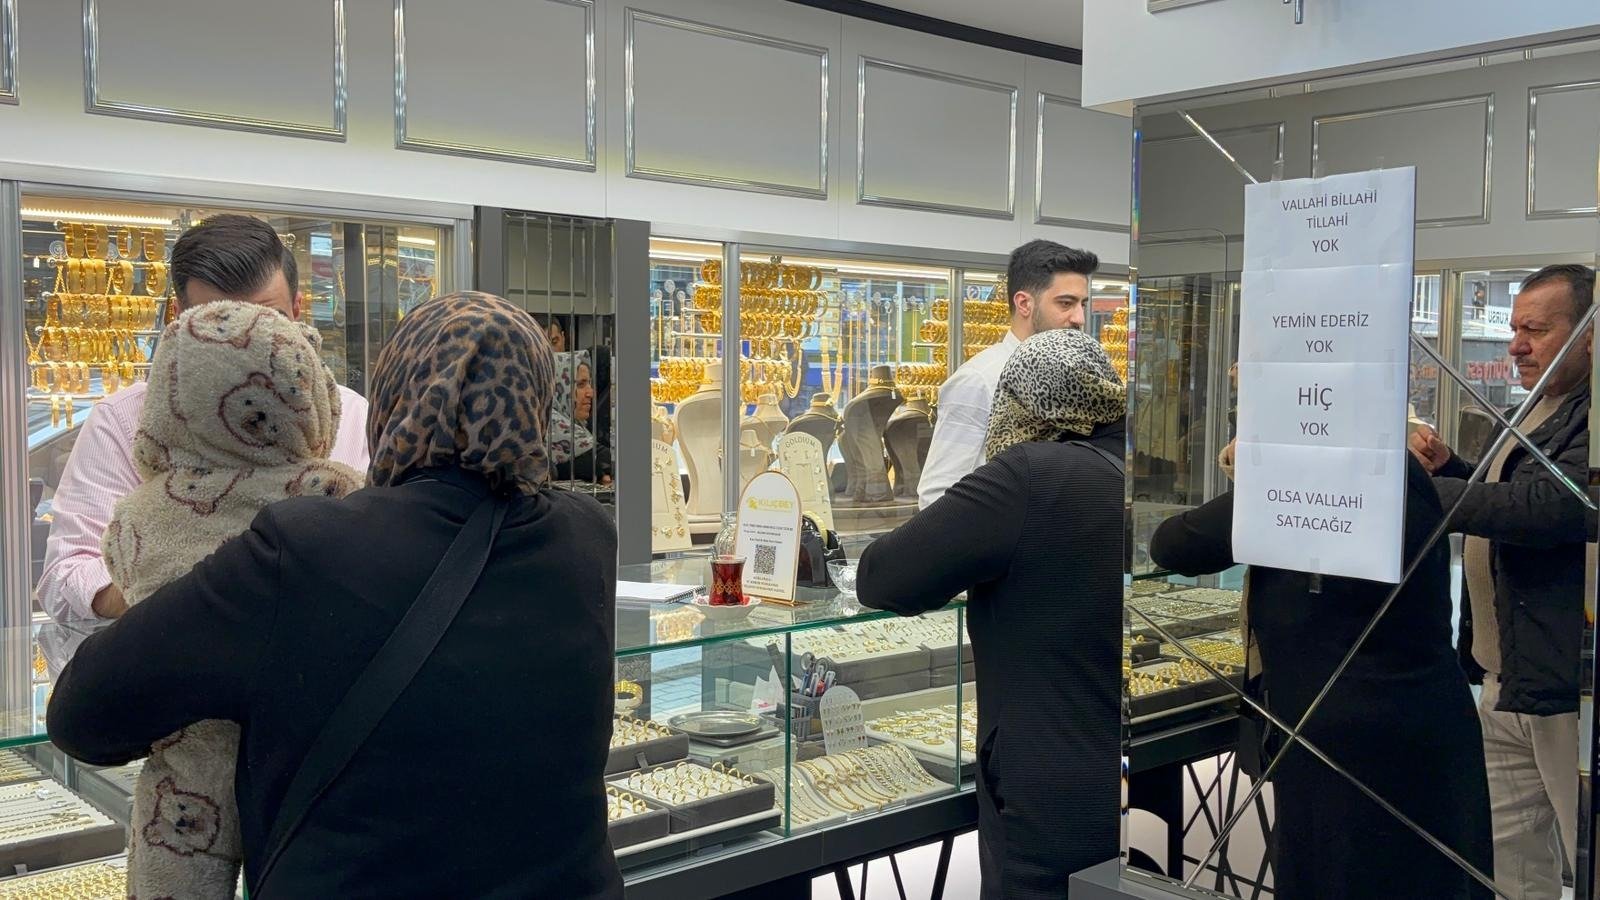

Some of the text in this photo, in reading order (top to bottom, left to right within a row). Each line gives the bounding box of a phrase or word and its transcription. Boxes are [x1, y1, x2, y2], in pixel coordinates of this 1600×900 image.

[1282, 190, 1378, 212] VALLAHİ BİLLAHİ
[1305, 211, 1348, 229] TİLLAHİ
[1312, 239, 1339, 253] YOK
[1272, 312, 1369, 329] YEMİN EDERİZ
[1305, 339, 1334, 353] YOK
[1298, 383, 1333, 411] HİÇ
[1299, 422, 1329, 437] YOK
[1267, 489, 1363, 510] OLSA VALLAHİ
[1276, 514, 1353, 534] SATACAĞIZ
